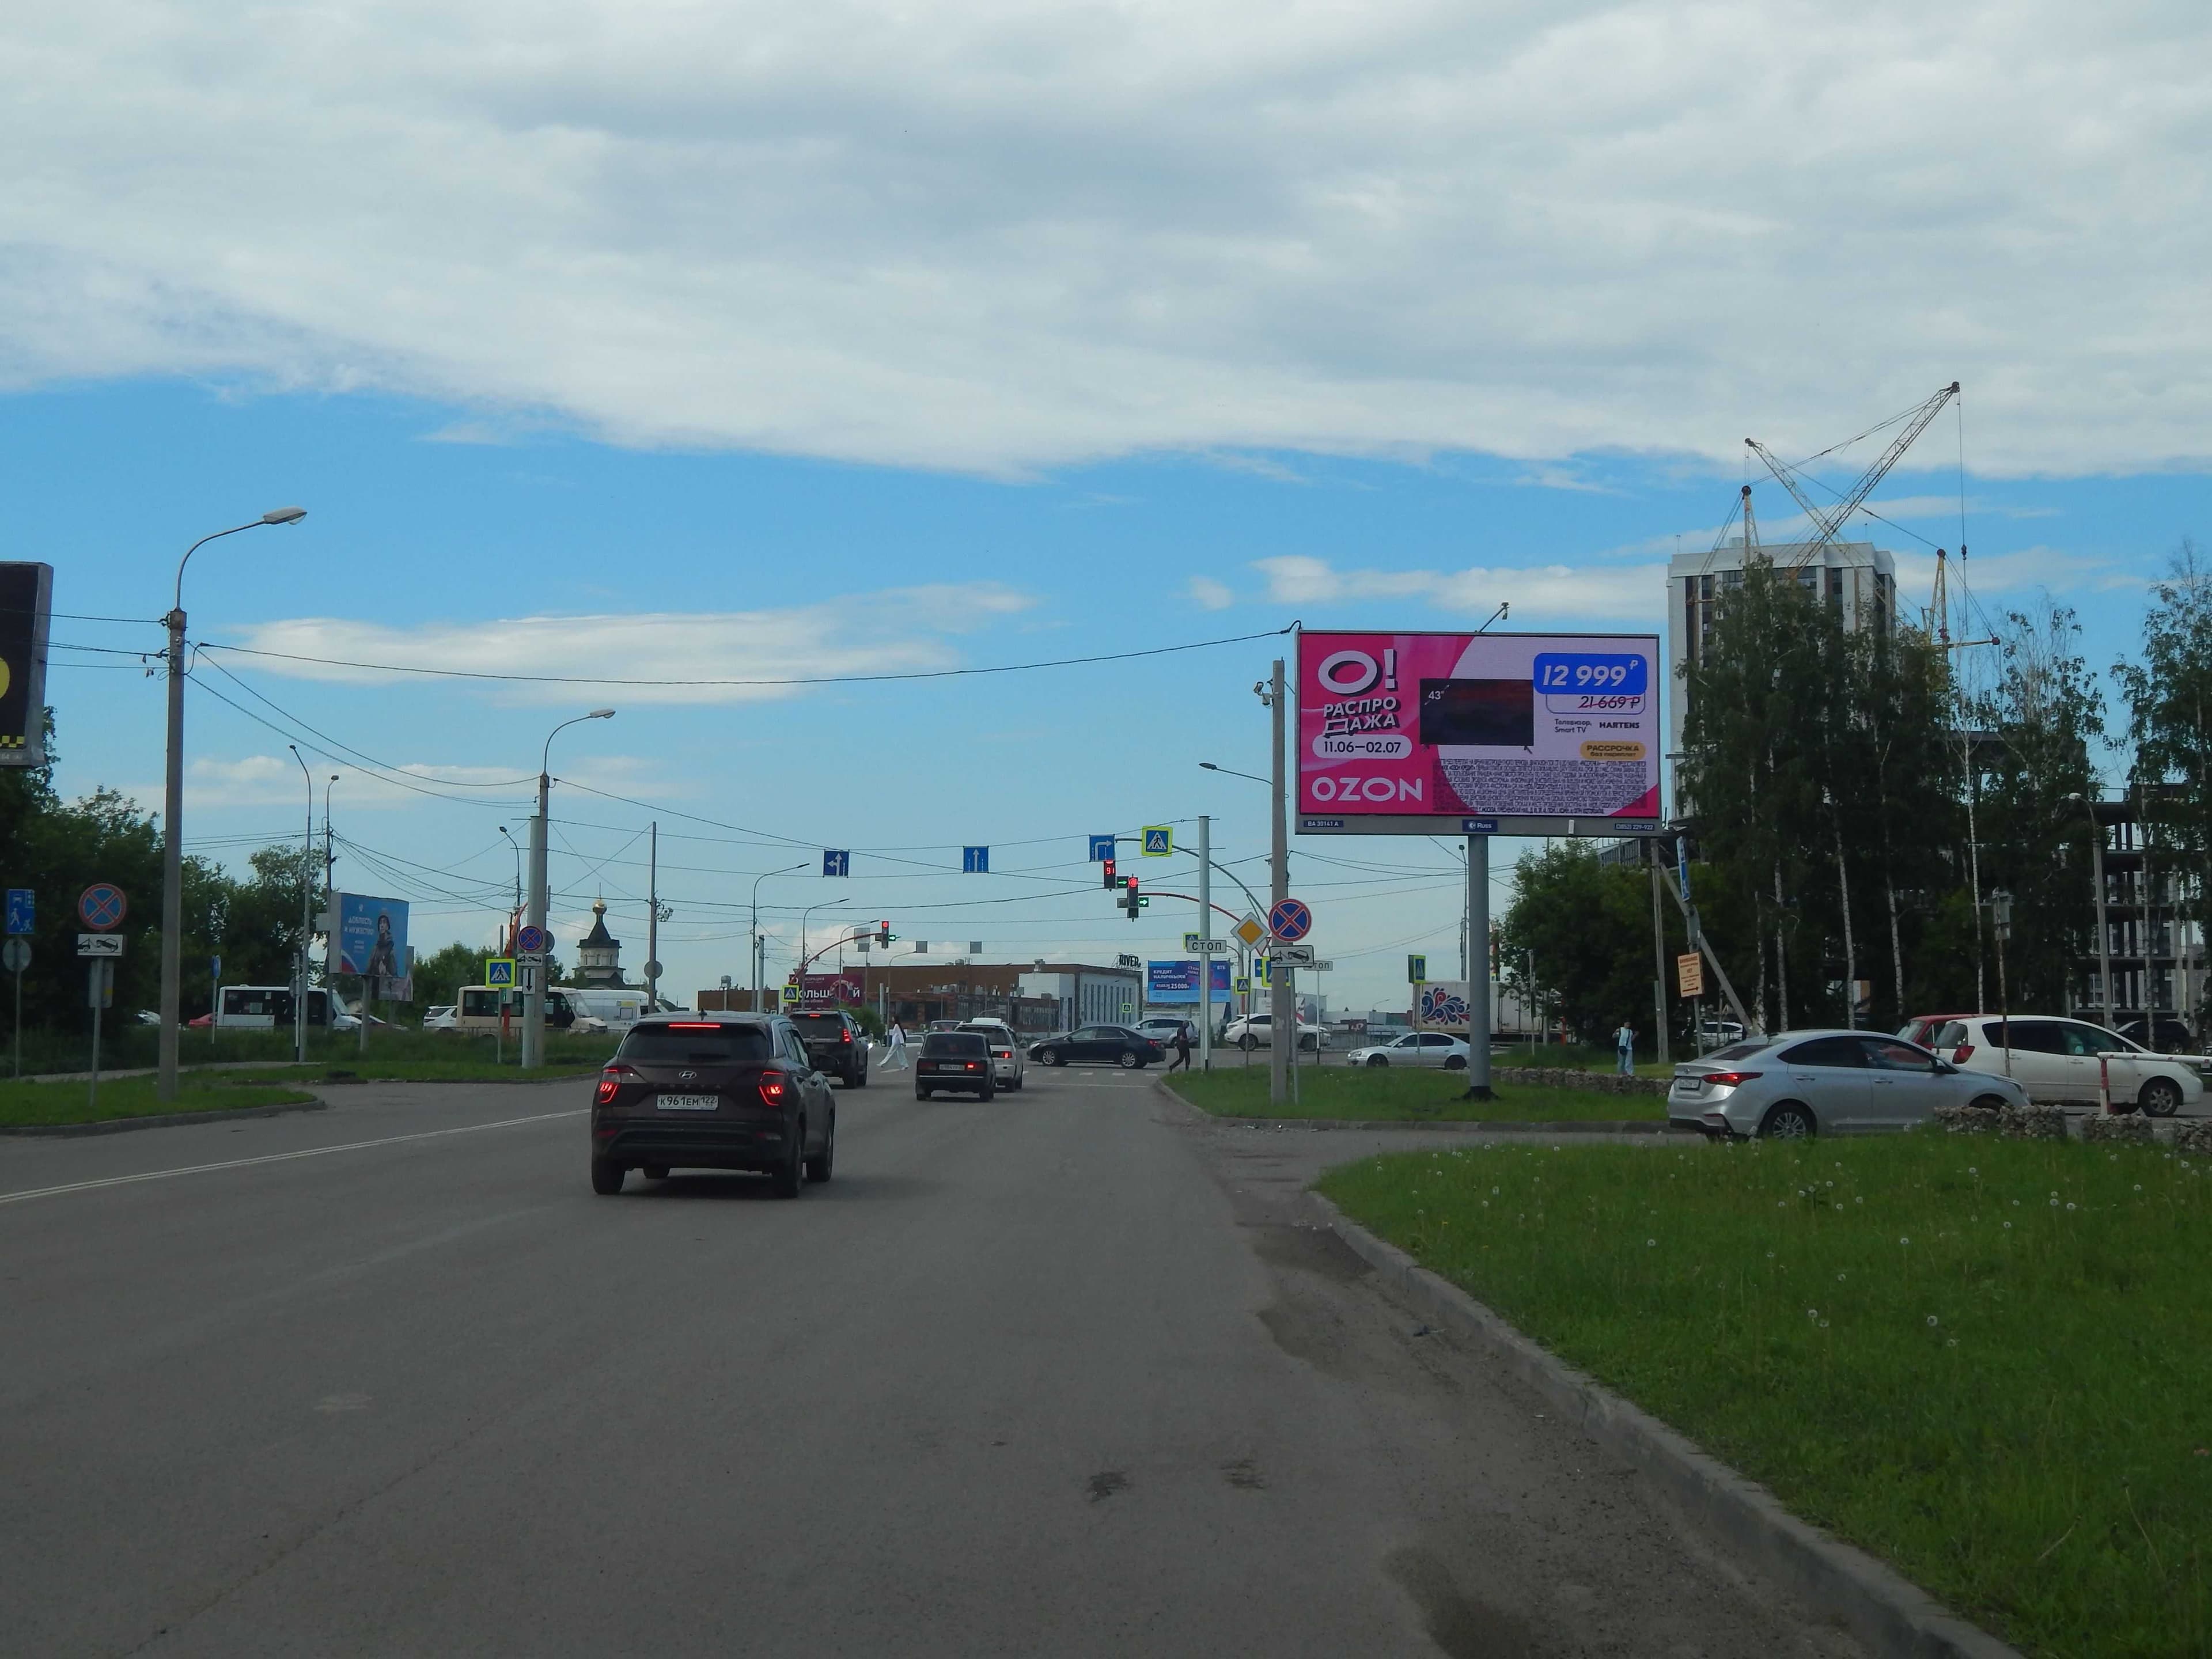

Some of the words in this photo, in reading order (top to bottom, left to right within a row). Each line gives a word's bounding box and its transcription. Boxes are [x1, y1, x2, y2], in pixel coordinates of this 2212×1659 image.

[1543, 665, 1569, 686] 12
[1323, 696, 1397, 718] РАСПРО
[1323, 713, 1396, 735] ДАЖА
[1311, 777, 1423, 802] OZON
[1192, 942, 1222, 950] СТОП
